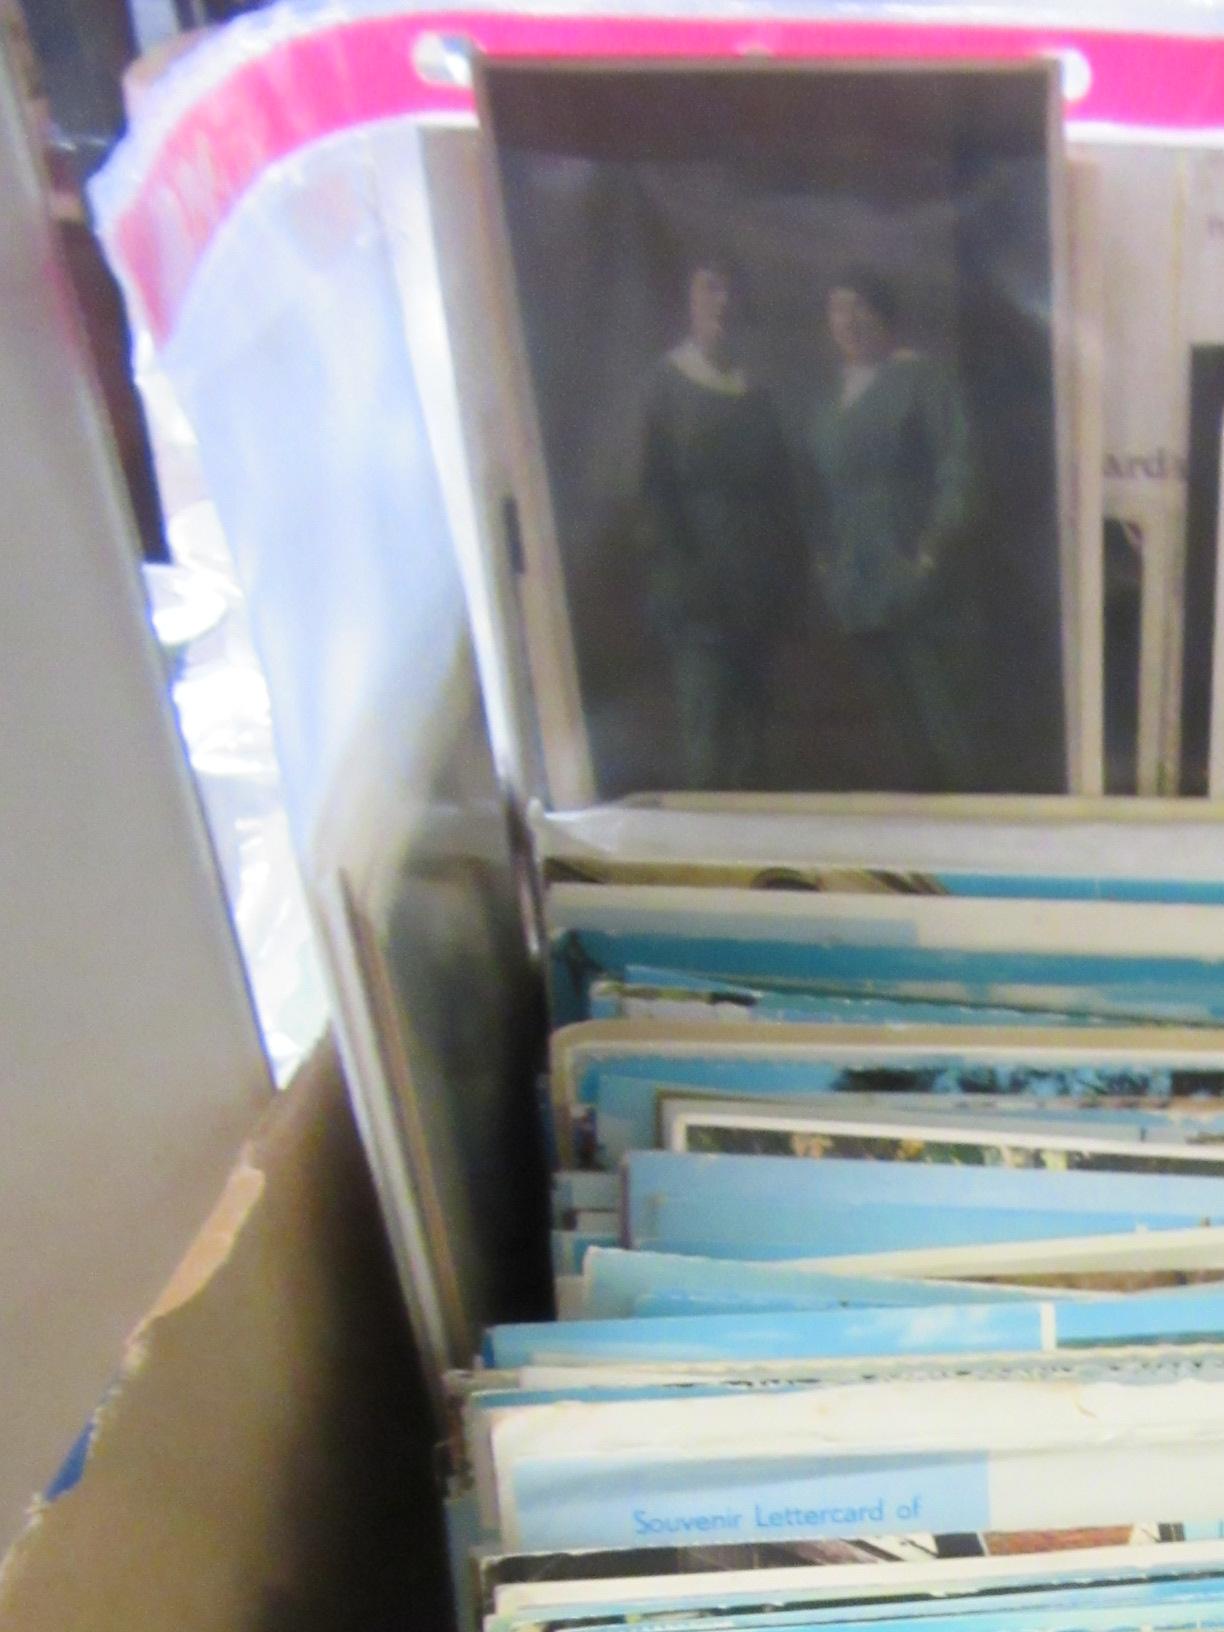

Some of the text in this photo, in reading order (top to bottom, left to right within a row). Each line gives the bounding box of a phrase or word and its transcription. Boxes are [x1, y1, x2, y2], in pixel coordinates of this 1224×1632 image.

[633, 1495, 921, 1534] Souvenir Lettercard of
